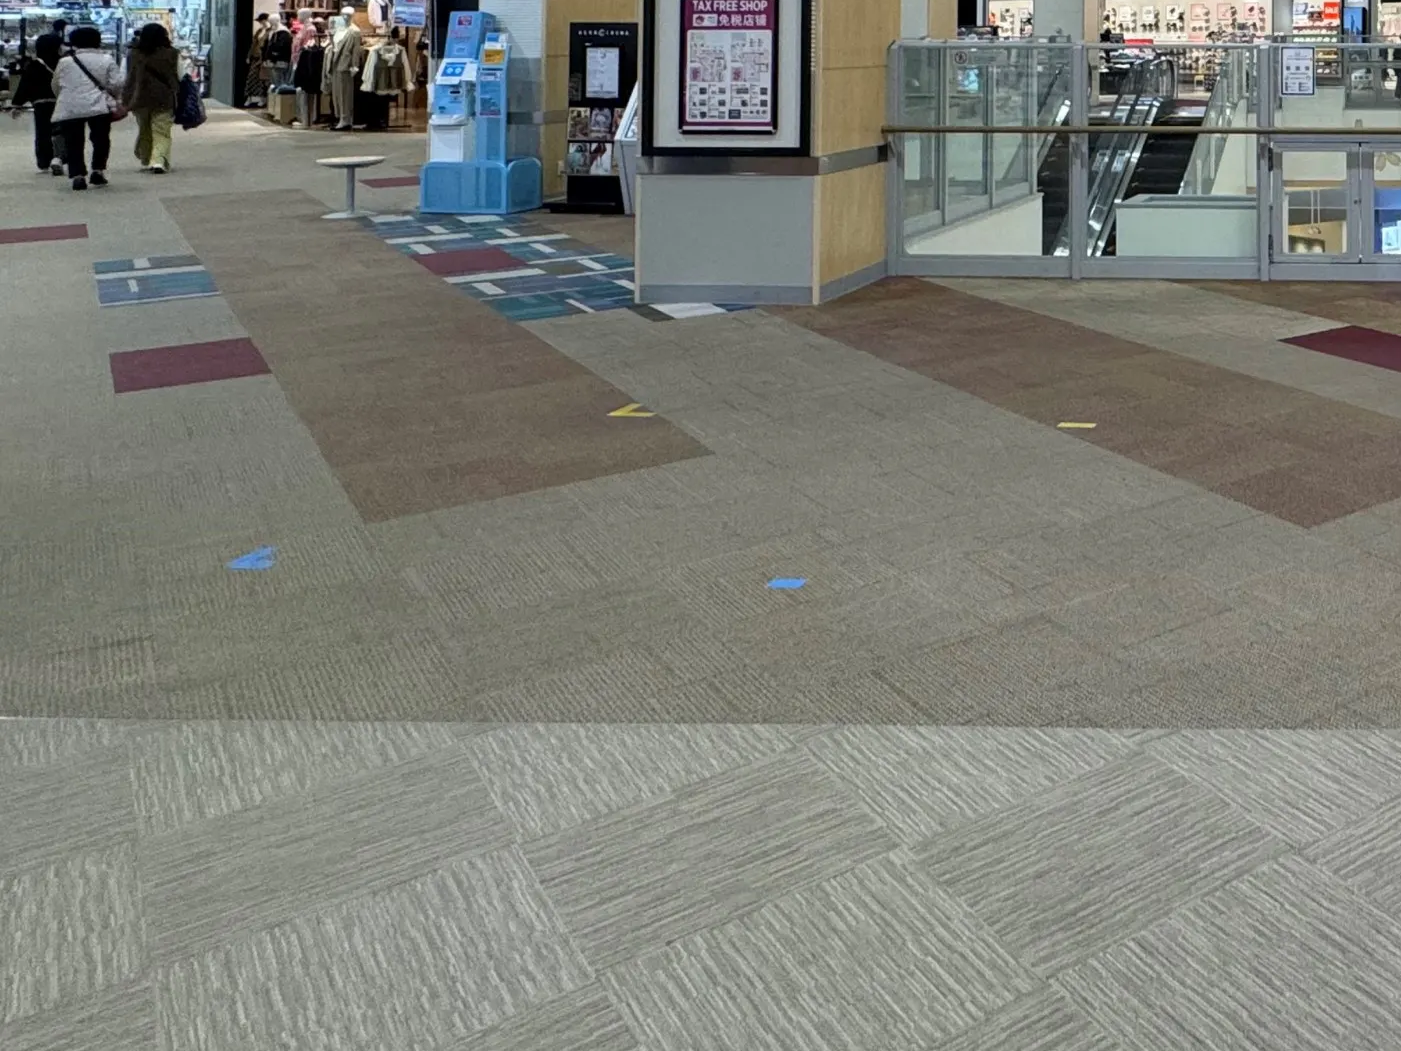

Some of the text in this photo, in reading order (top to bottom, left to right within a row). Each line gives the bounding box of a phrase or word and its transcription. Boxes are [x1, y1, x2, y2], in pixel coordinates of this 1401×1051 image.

[692, 0, 768, 12] TAX FREE SHOP
